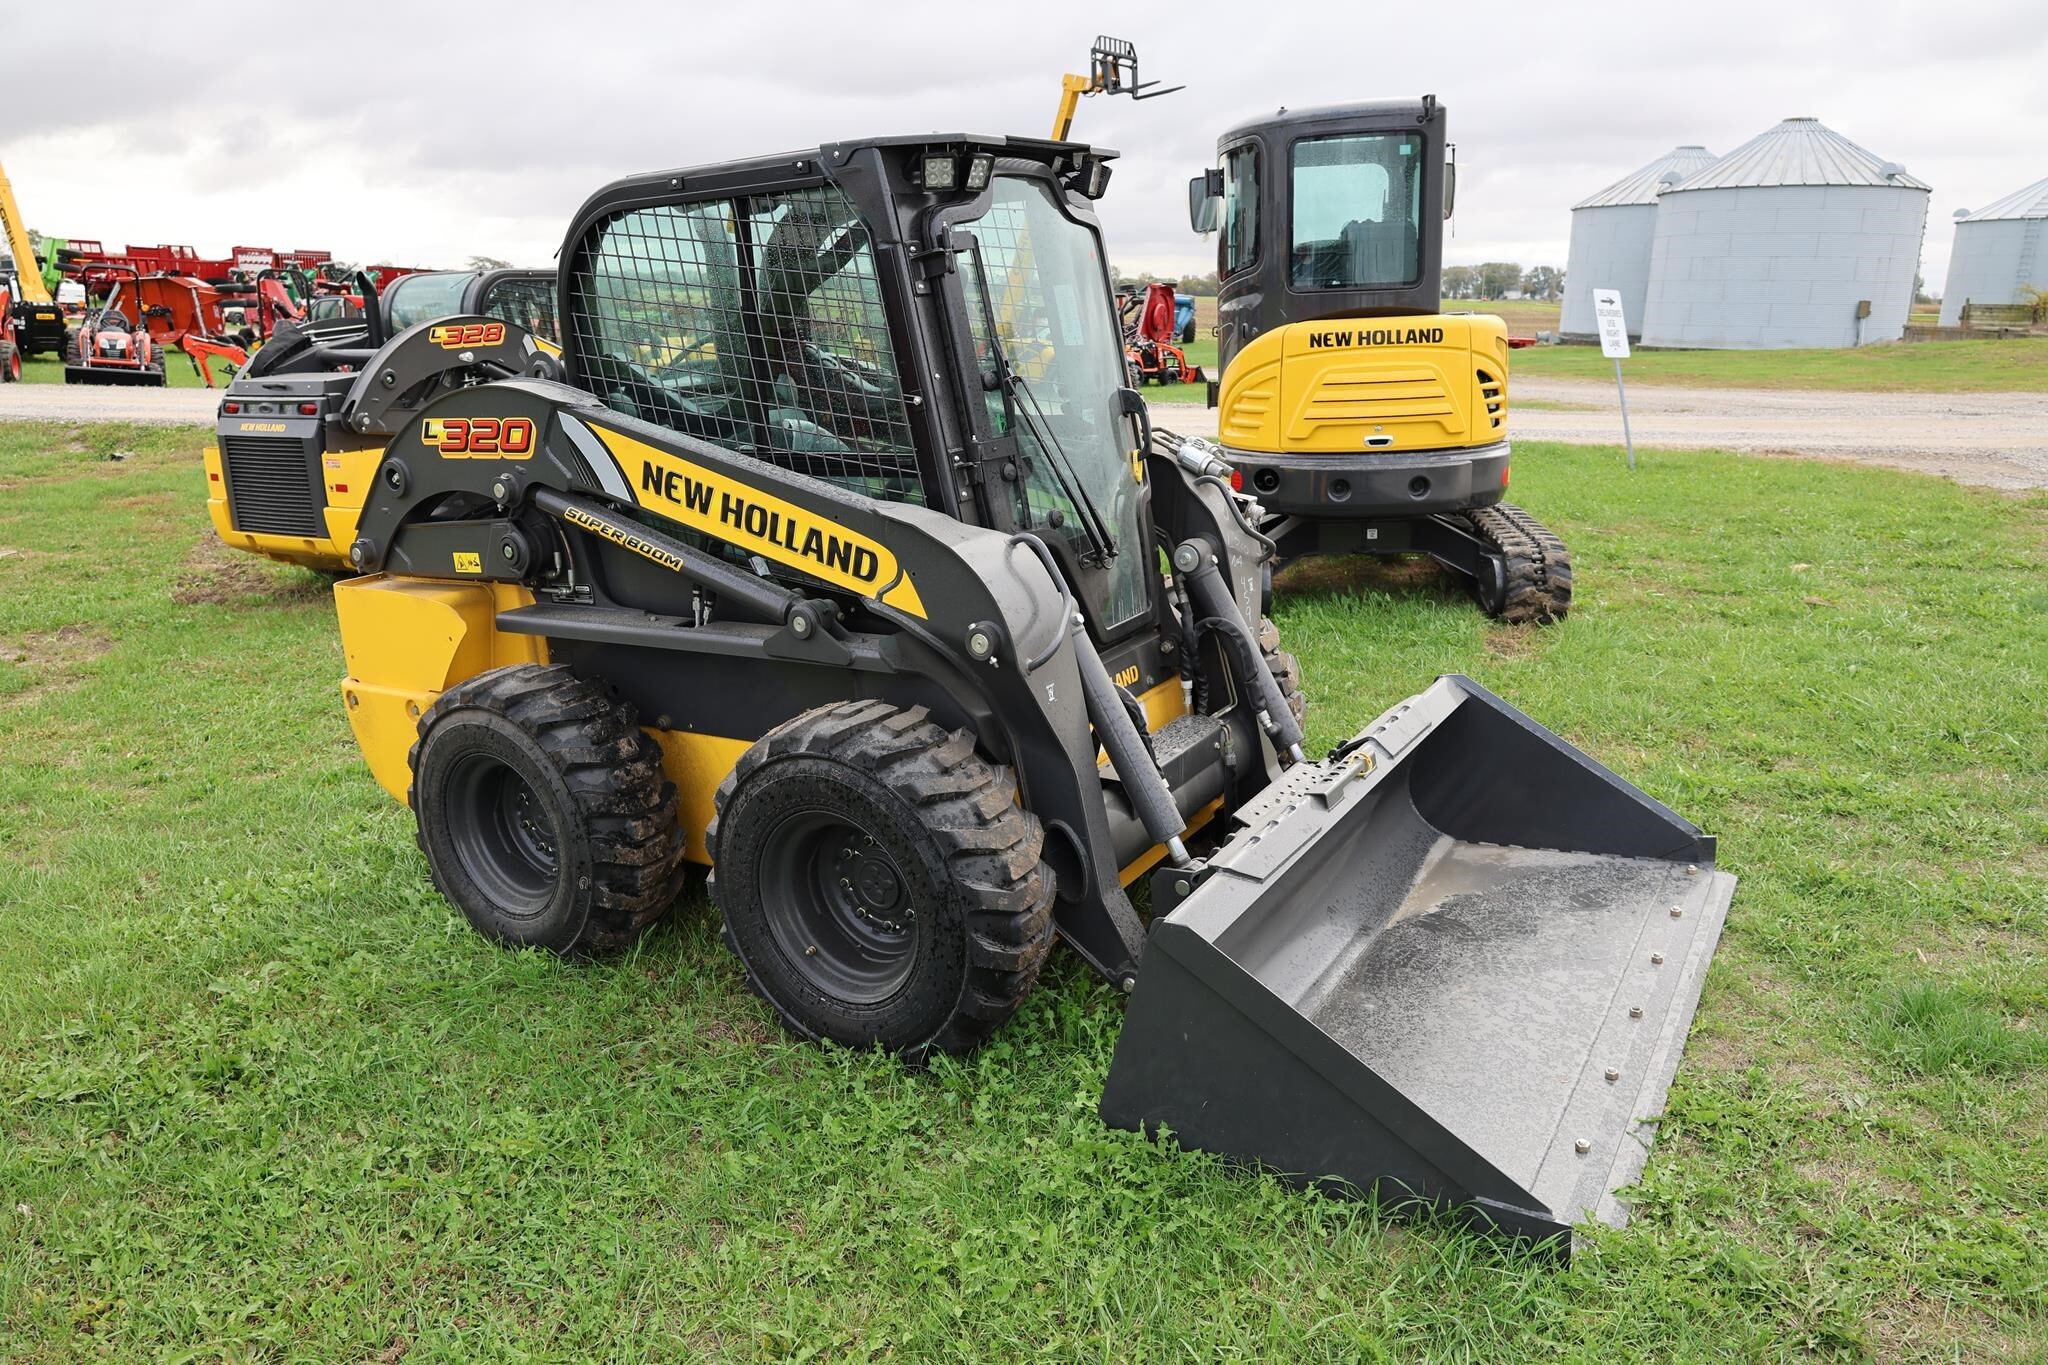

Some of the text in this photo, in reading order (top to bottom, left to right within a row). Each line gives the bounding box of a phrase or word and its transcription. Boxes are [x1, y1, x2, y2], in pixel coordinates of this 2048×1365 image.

[429, 323, 506, 349] L328
[1310, 328, 1443, 348] NEW HOLLAND
[240, 422, 286, 433] NEW HOLLAND
[422, 418, 536, 459] L320
[642, 461, 879, 583] NEW HOLLAND
[564, 507, 684, 572] SUPER BOOM
[1109, 664, 1139, 688] AND
